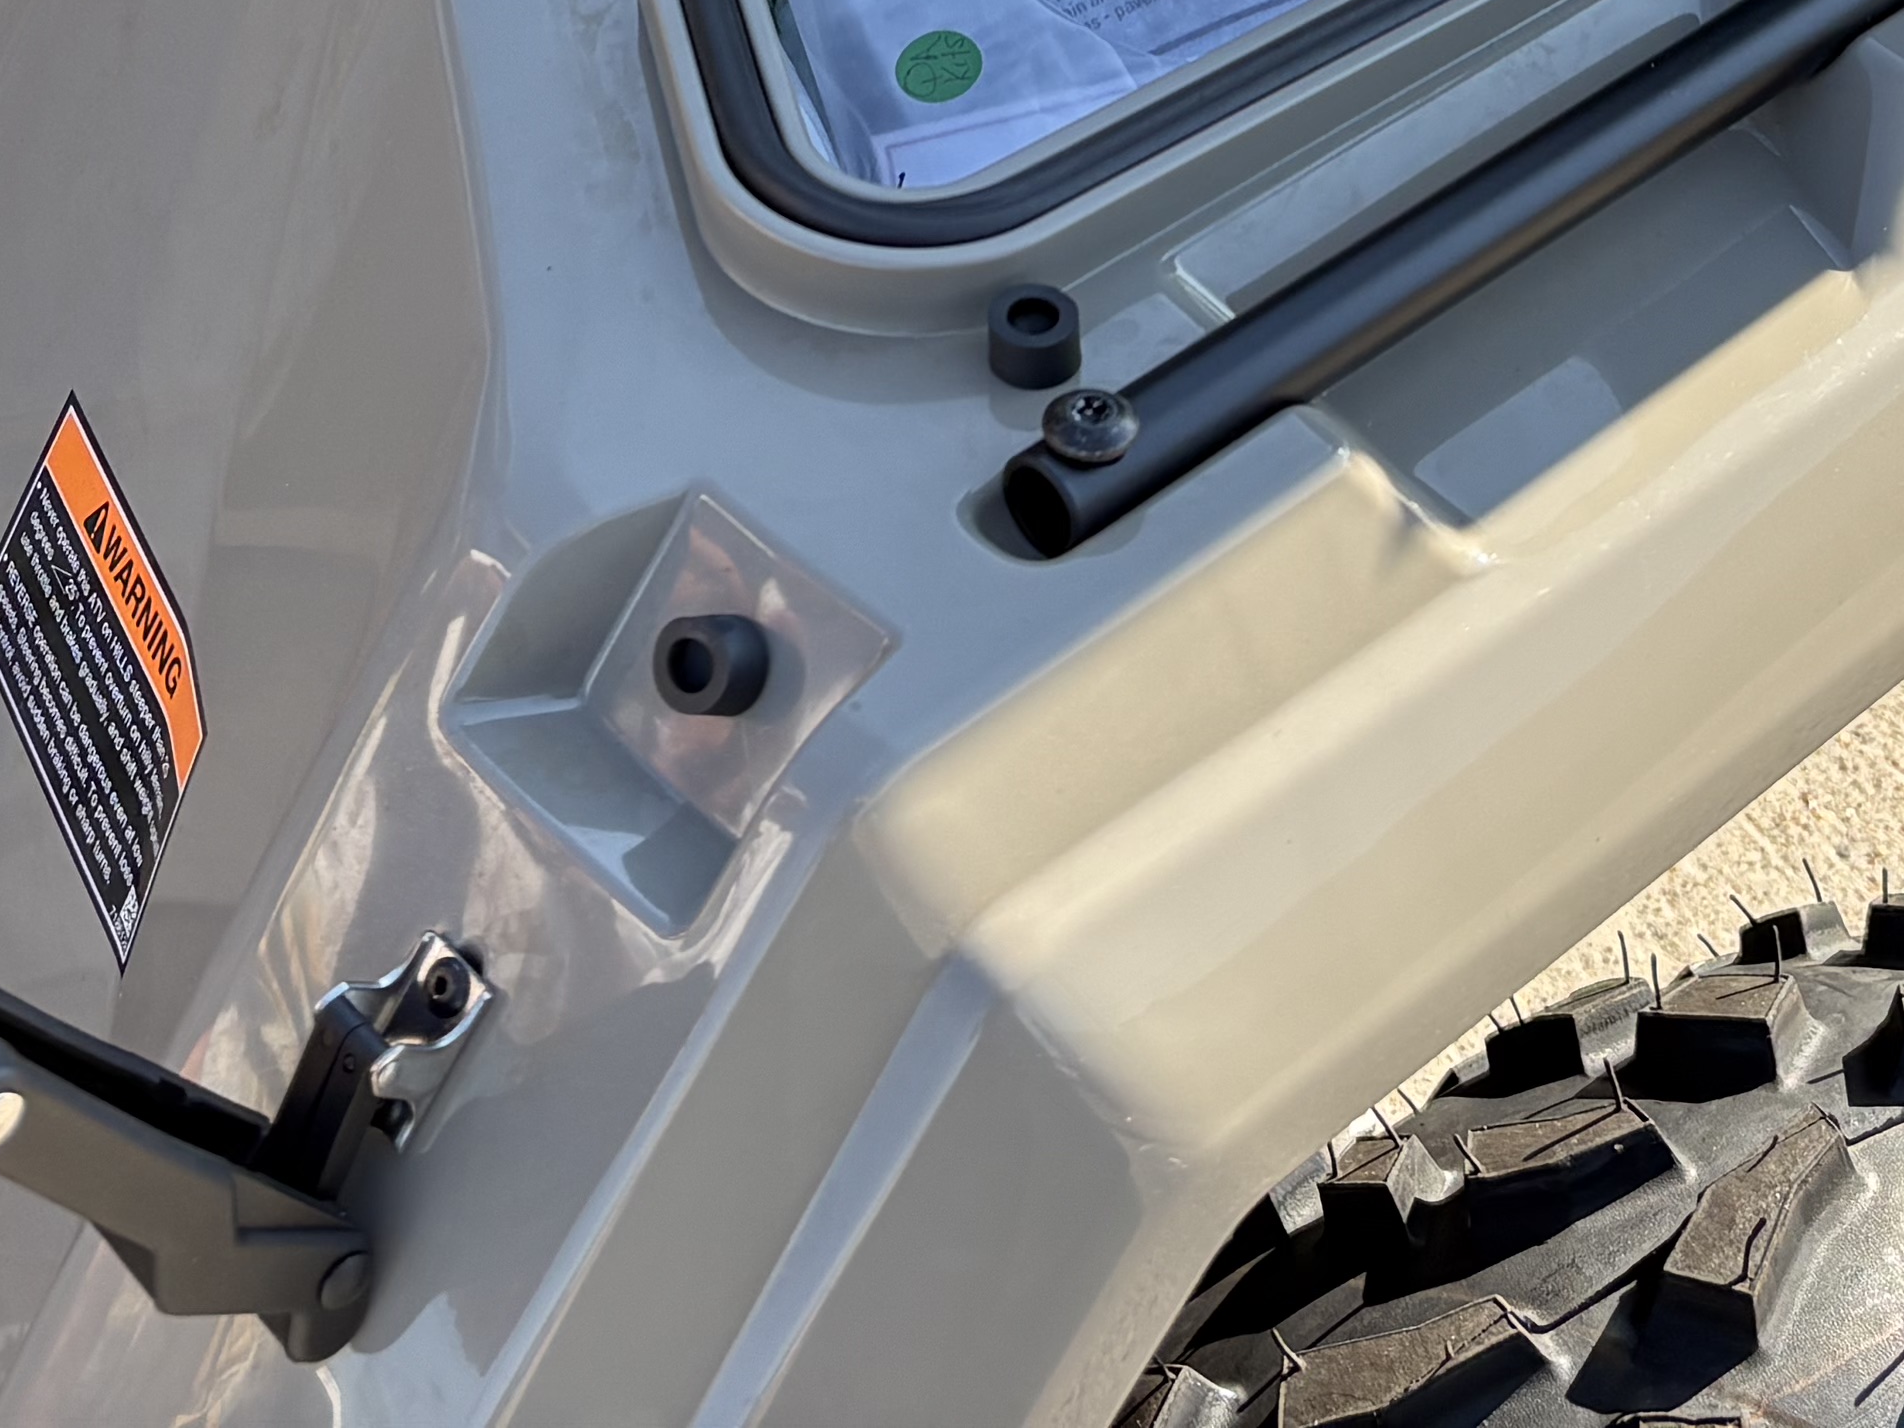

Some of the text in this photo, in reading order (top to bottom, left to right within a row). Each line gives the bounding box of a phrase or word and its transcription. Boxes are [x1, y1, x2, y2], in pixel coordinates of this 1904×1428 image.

[5, 560, 37, 627] REVERSE
[33, 625, 61, 684] operation
[59, 681, 72, 708] can
[69, 702, 80, 726] be
[78, 724, 111, 794] dangerous
[109, 791, 127, 828] even
[124, 825, 135, 844] at
[39, 487, 59, 527] Never
[56, 526, 79, 573] operate
[77, 568, 90, 595] this
[87, 592, 105, 622] ATV
[101, 622, 112, 642] on
[109, 636, 132, 681] HILLS
[129, 680, 154, 729] steeper
[49, 595, 64, 622] and
[60, 615, 82, 663] brakes
[78, 661, 109, 726] gradually,
[107, 722, 123, 750] and
[120, 748, 137, 780] shift
[75, 602, 85, 627] To
[81, 624, 107, 675] prevent
[105, 672, 131, 727] overturn
[129, 725, 140, 746] on
[103, 524, 181, 699] WARNING
[12, 661, 31, 698] avoid
[27, 695, 49, 743] sudden
[47, 737, 71, 793] braking
[68, 788, 78, 805] or
[75, 803, 95, 844] sharp
[92, 839, 111, 884] turns.
[17, 627, 41, 685] Steering
[38, 676, 66, 738] becomes
[64, 736, 88, 787] difficult.
[87, 781, 97, 807] To
[94, 804, 121, 858] prevent
[118, 851, 133, 891] loss
